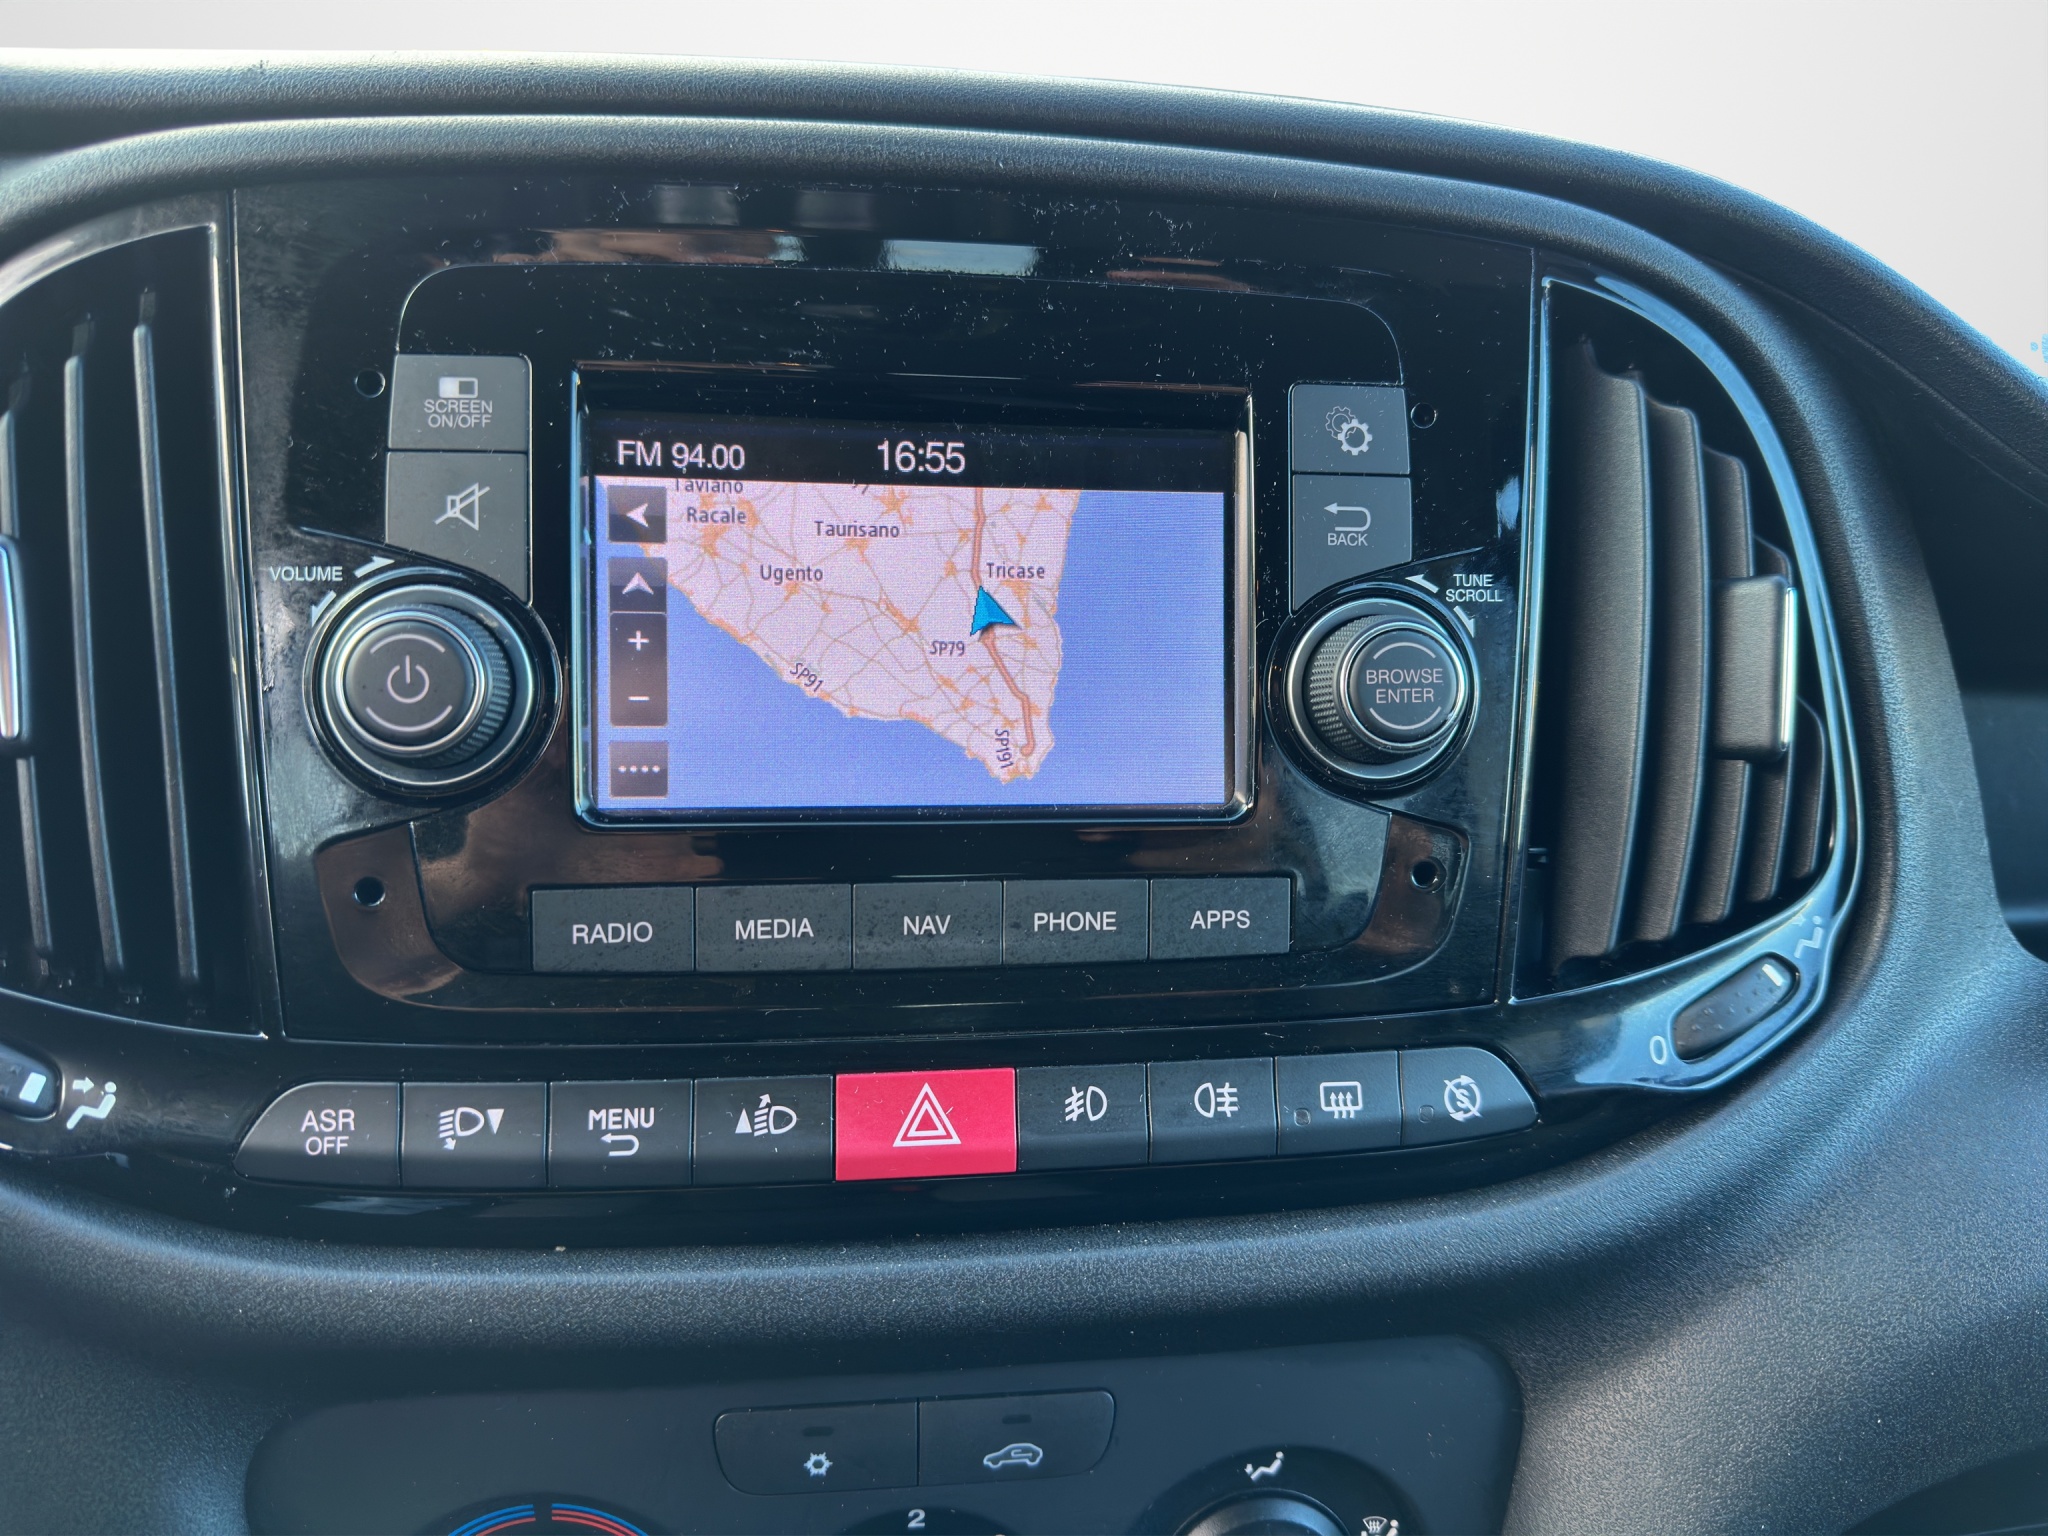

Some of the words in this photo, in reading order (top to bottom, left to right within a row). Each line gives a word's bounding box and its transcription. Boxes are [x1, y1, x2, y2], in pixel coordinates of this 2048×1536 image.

[423, 399, 493, 414] SCREEN
[427, 414, 492, 428] ON/OFF
[617, 440, 661, 466] FM
[671, 442, 745, 470] 94.00
[877, 440, 966, 475] 16:55
[686, 506, 747, 524] Racale
[815, 521, 900, 538] Taurisano
[1327, 533, 1368, 546] BACK
[269, 565, 343, 582] VOLUME
[759, 565, 824, 583] Ugento
[986, 562, 1045, 579] Tricase
[1453, 573, 1494, 587] TUNE
[1445, 588, 1503, 602] SCROLL
[929, 640, 966, 656] SP79
[789, 662, 825, 693] SP91
[1366, 668, 1444, 685] BROWSE
[1376, 688, 1435, 704] ENTER
[993, 728, 1014, 769] SP191
[735, 917, 815, 941] MEDIA
[902, 914, 952, 936] NAV
[1033, 910, 1118, 932] PHONE
[1190, 909, 1251, 930] APPS
[571, 921, 653, 945] RADIO
[300, 1109, 356, 1133] ASR
[587, 1107, 655, 1131] MENU
[304, 1134, 349, 1156] OFF
[907, 1508, 926, 1529] 2
